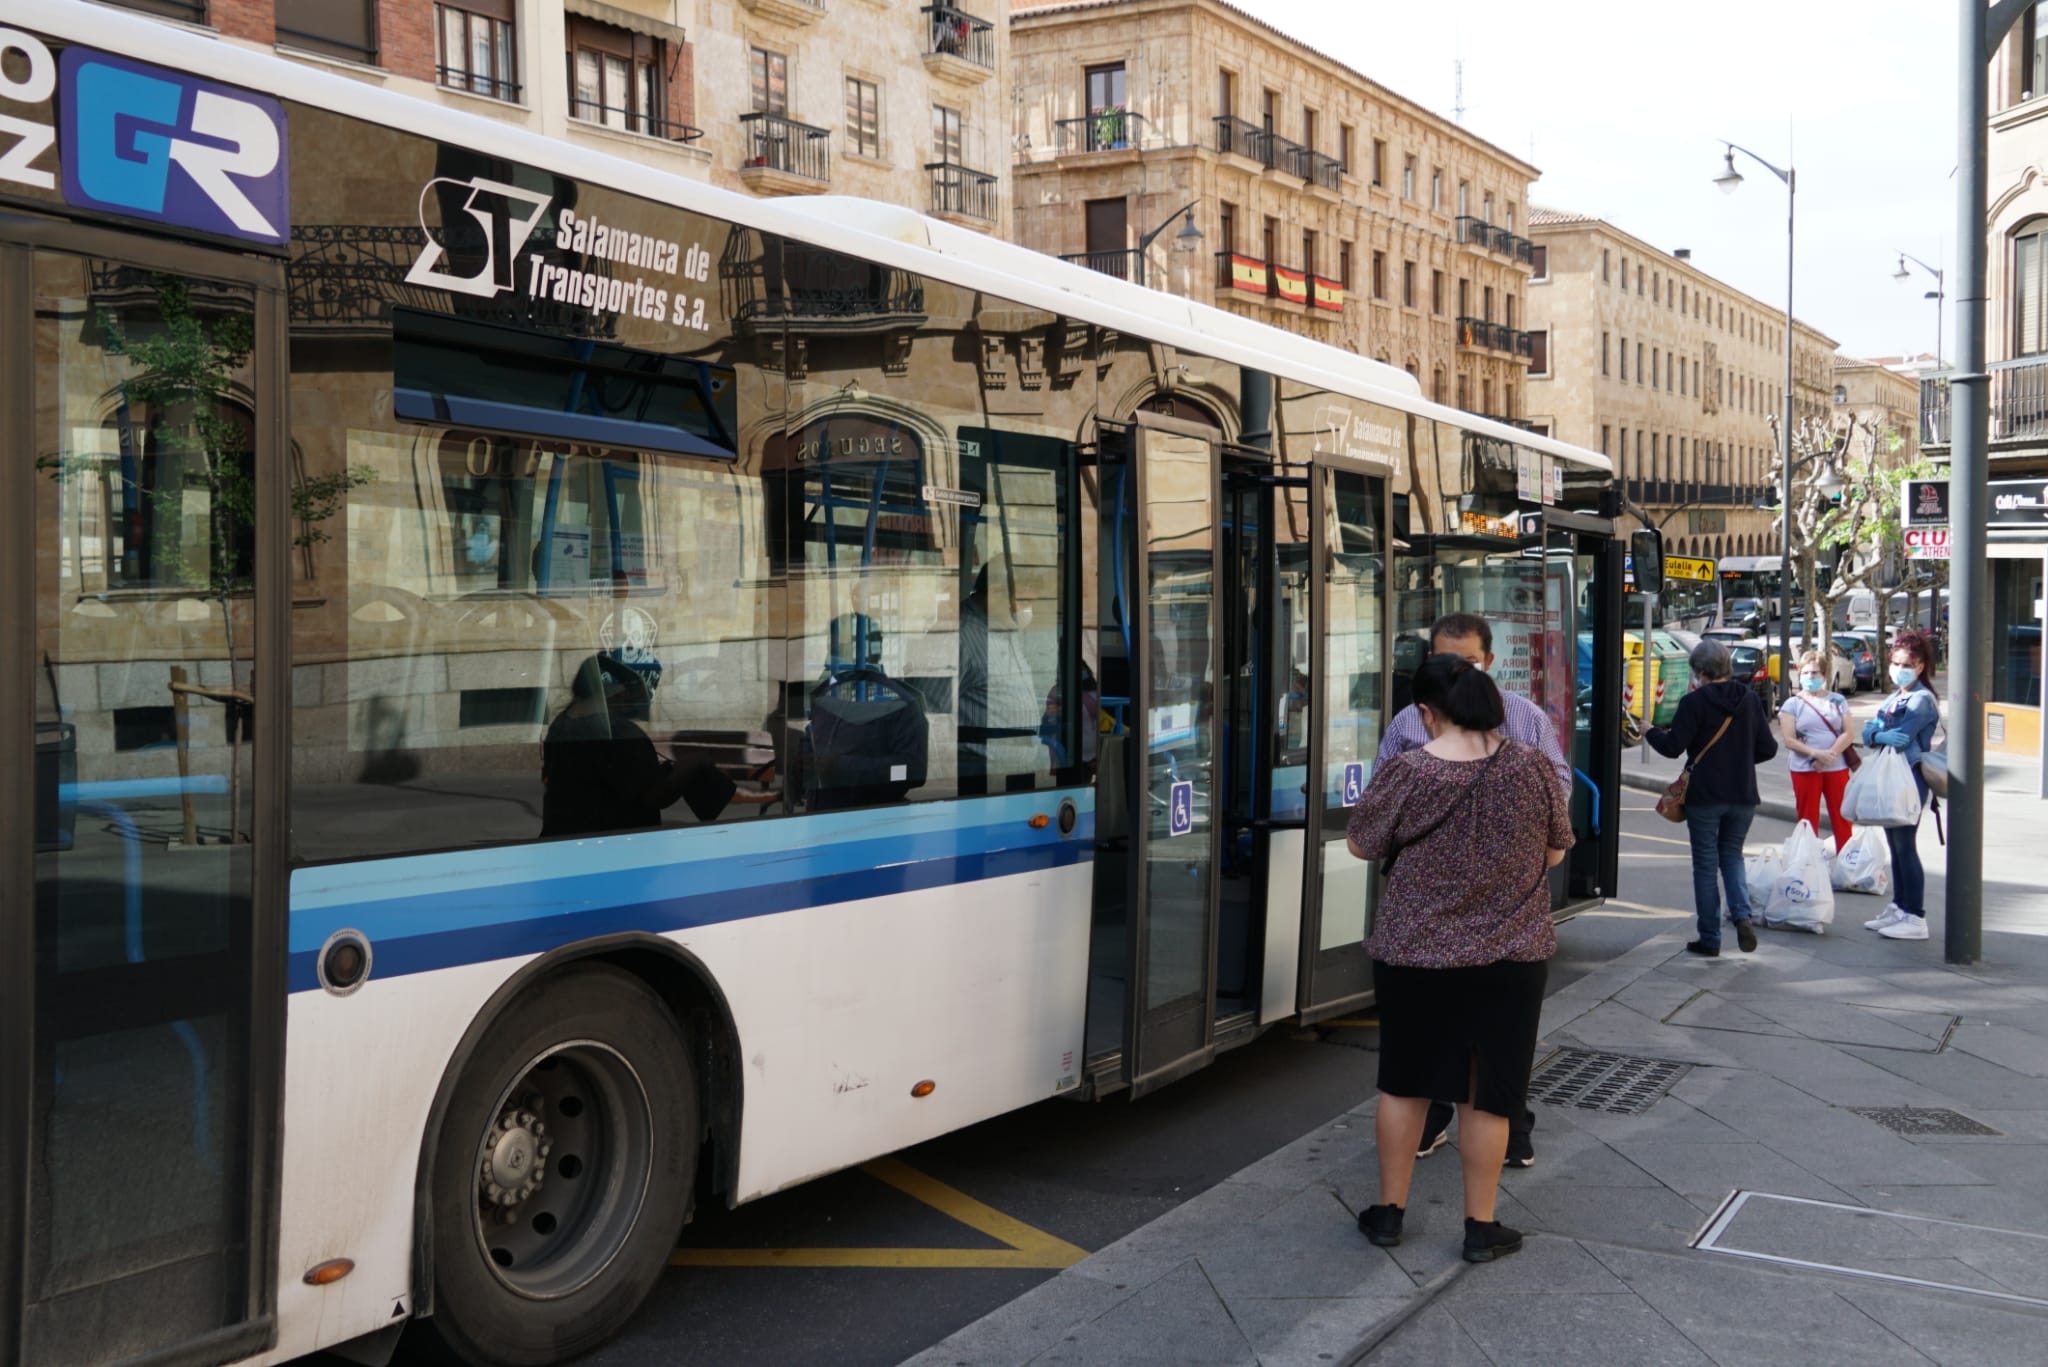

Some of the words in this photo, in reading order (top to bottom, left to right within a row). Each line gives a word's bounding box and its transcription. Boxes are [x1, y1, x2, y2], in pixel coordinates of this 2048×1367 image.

[556, 208, 680, 275] Salamanca
[684, 242, 710, 282] de
[529, 253, 666, 322] Transportes
[672, 293, 709, 331] s.a.
[1905, 531, 1952, 547] CLU
